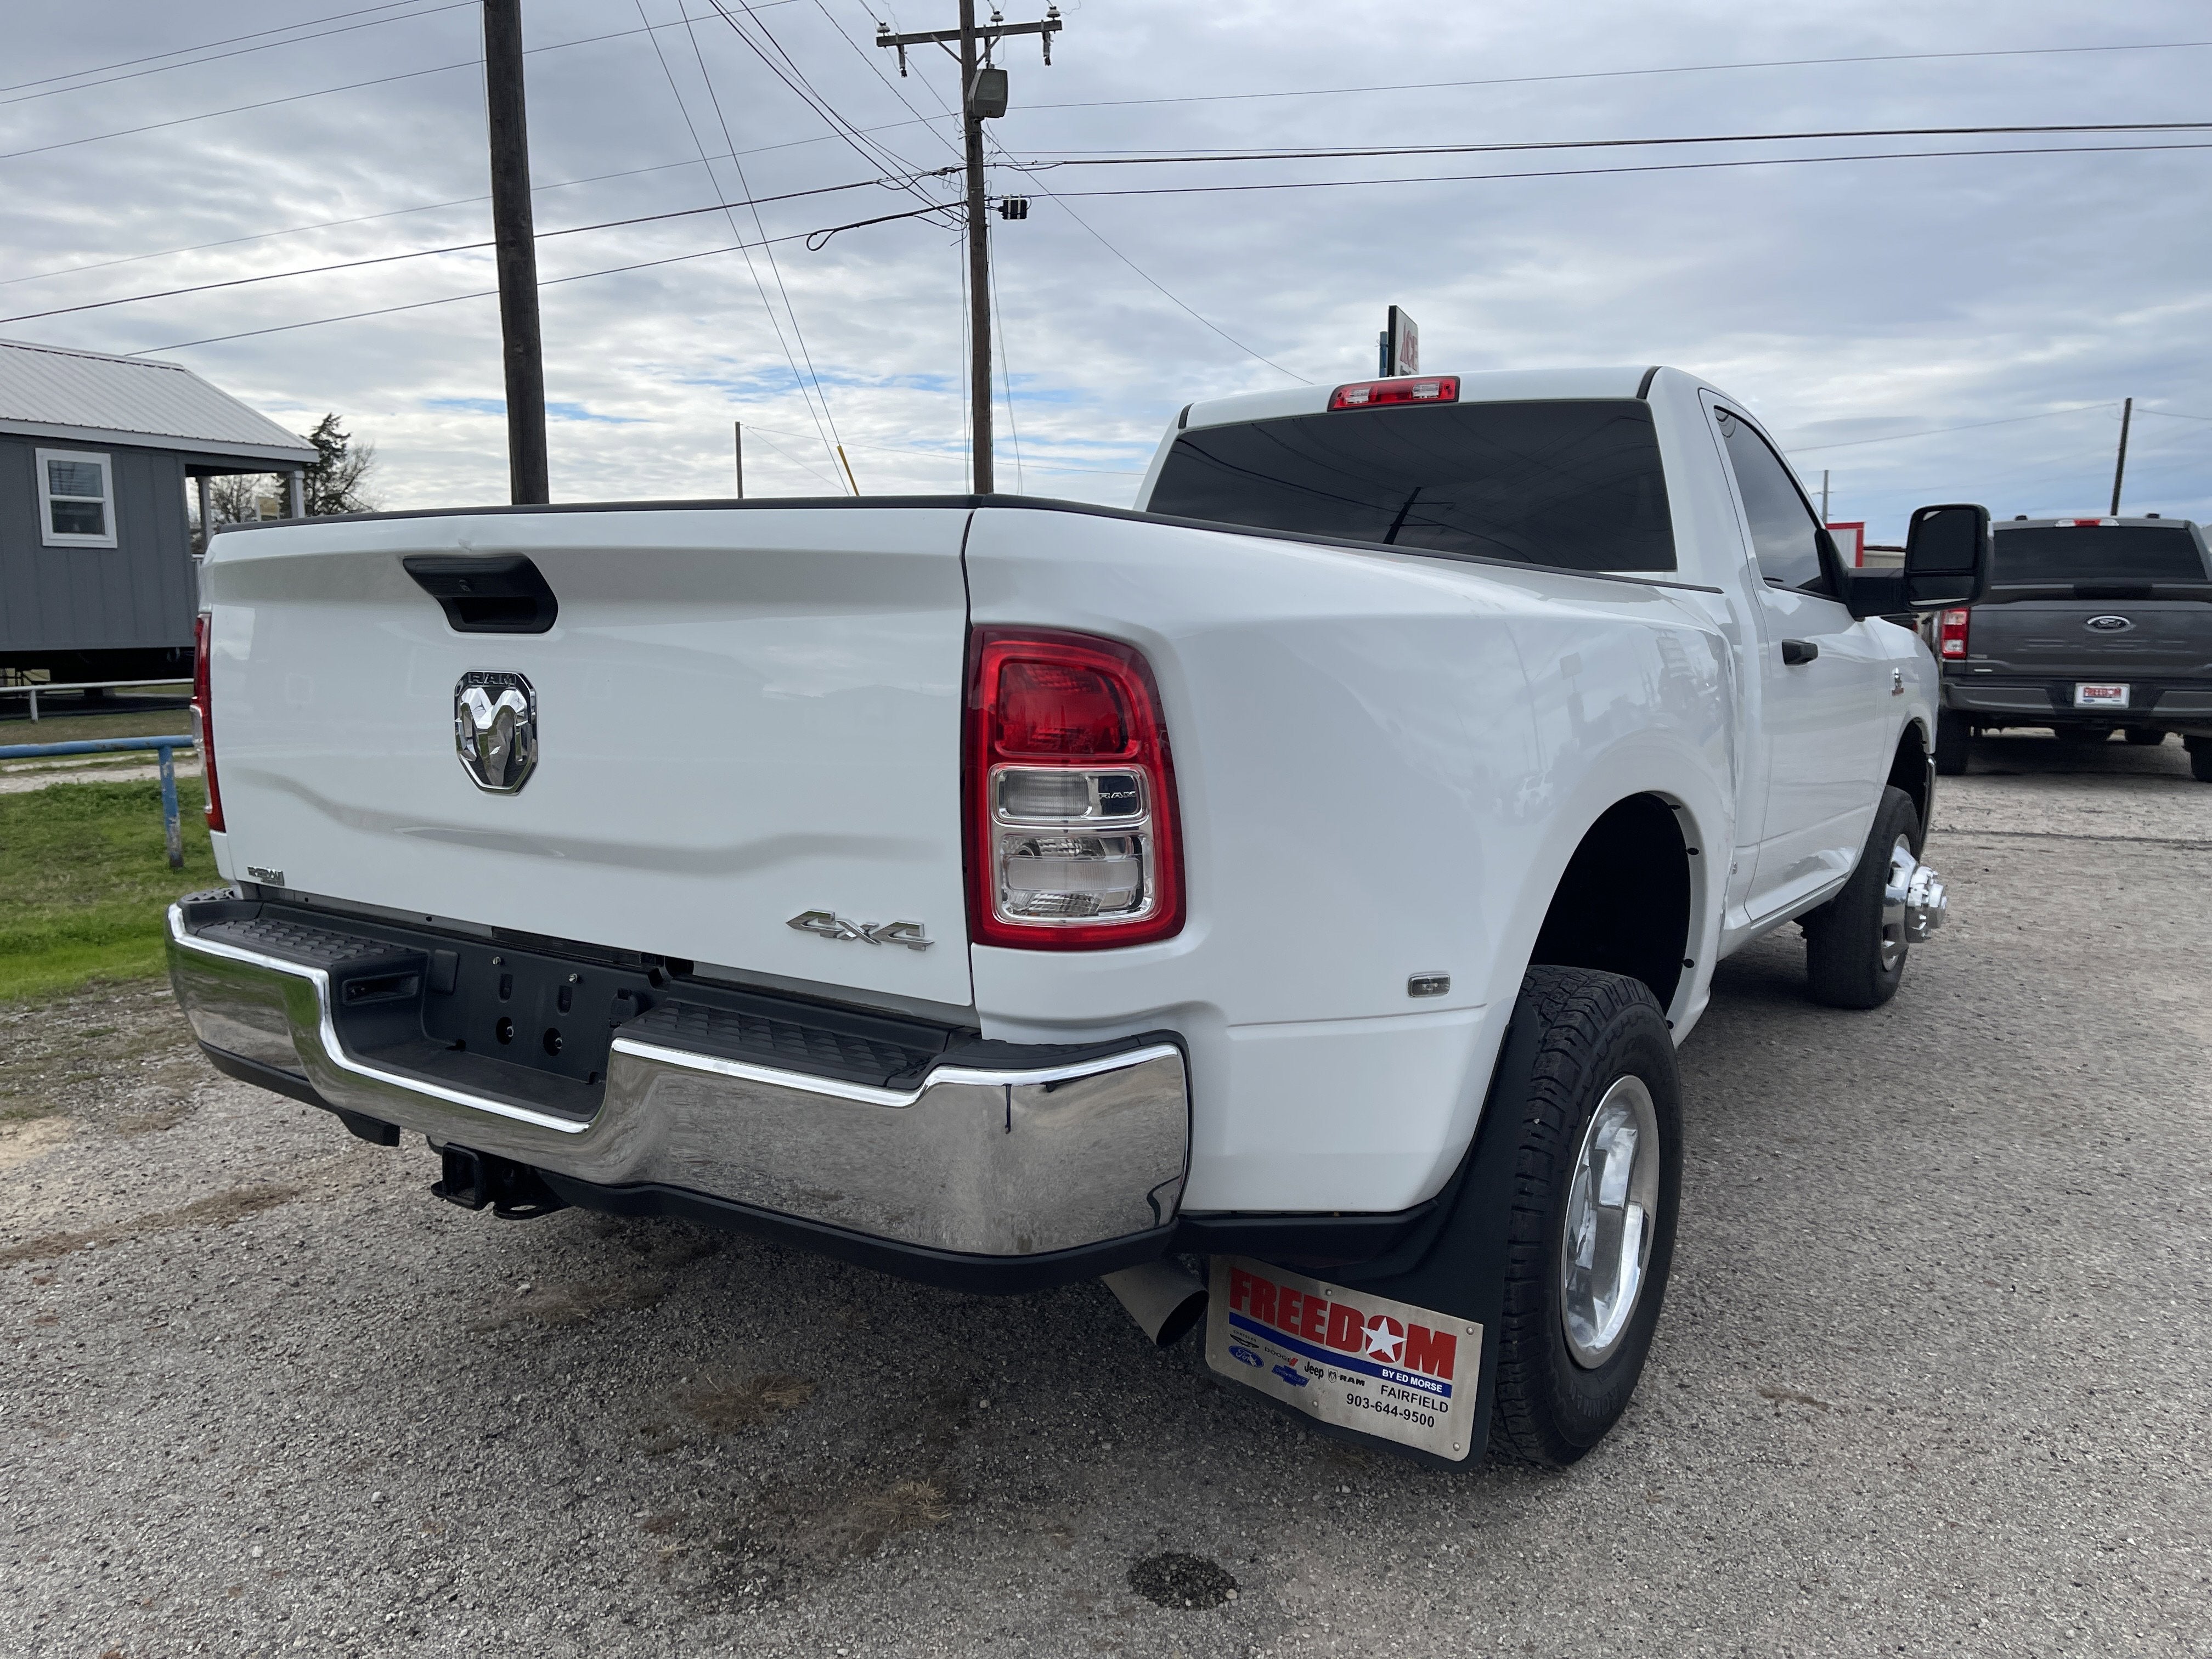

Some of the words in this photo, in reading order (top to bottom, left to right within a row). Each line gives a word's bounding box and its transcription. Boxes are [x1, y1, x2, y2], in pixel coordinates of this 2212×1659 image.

[1400, 322, 1418, 371] ACE
[468, 673, 516, 685] RAM
[1098, 791, 1137, 799] RAM
[1229, 1267, 1457, 1380] FREEDOM
[1265, 1347, 1292, 1362] DODGE
[1304, 1361, 1324, 1380] Jeep
[1340, 1374, 1365, 1387] RAM
[1382, 1369, 1395, 1379] BY
[1396, 1373, 1409, 1383] ED
[1410, 1376, 1442, 1393] MORSE
[1380, 1385, 1448, 1413] FAIRFIELD
[1346, 1392, 1435, 1428] 903-644-9500
